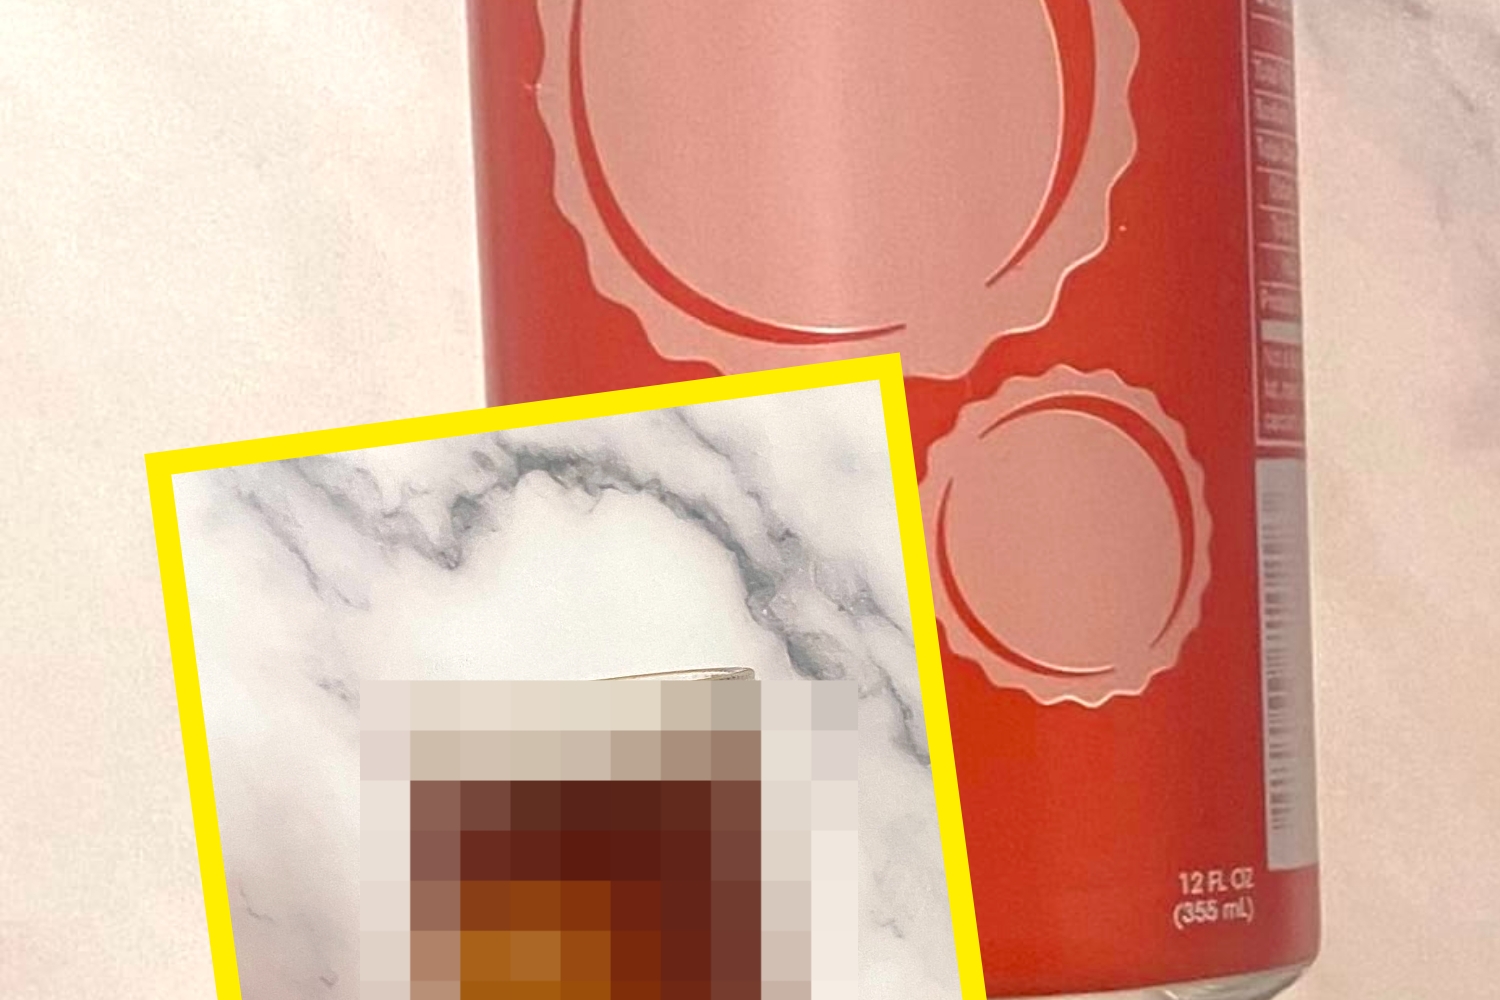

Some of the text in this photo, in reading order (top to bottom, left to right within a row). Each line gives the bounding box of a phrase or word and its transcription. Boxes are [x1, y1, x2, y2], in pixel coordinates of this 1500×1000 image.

[1178, 867, 1255, 895] 12 FL OZ
[1173, 899, 1218, 930] (355
